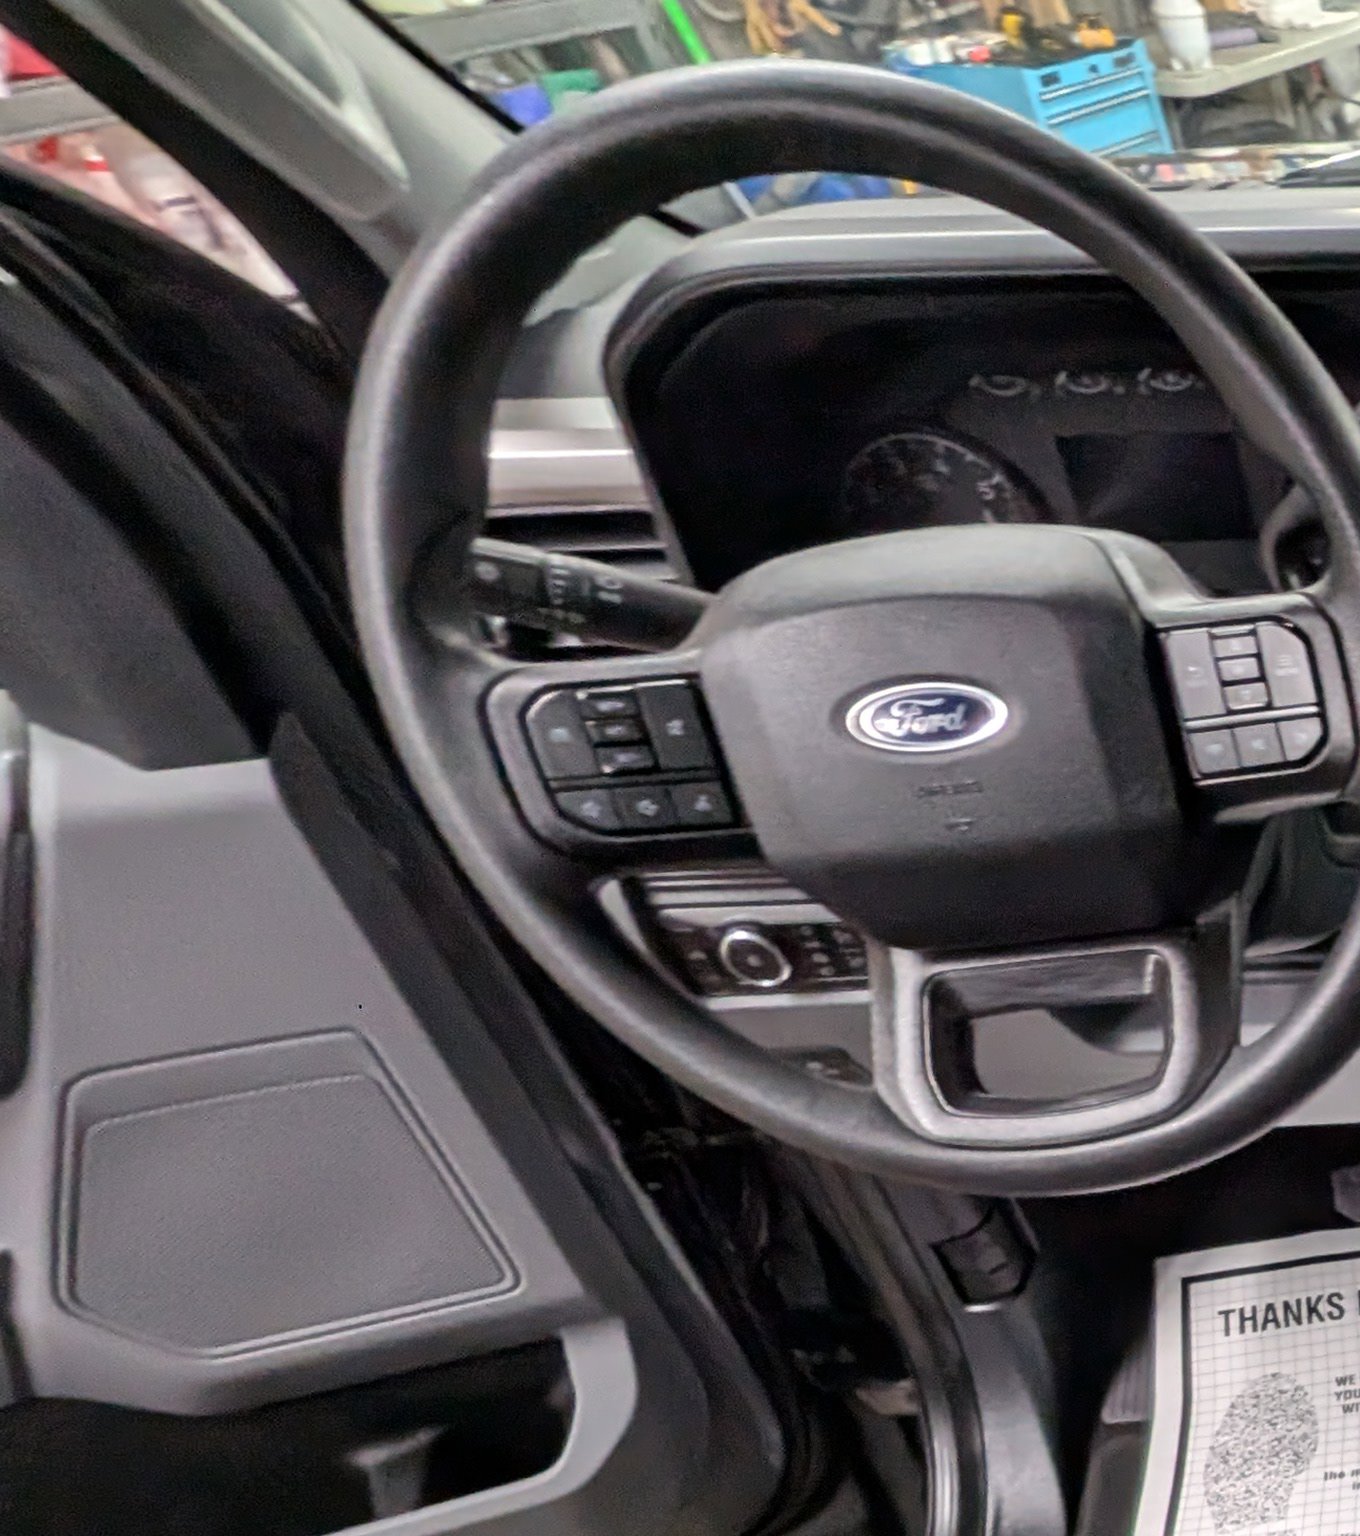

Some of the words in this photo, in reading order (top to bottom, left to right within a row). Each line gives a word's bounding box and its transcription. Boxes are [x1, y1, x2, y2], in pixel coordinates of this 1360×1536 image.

[874, 698, 968, 737] Ford
[1218, 1292, 1345, 1338] THANKS
[1335, 1374, 1356, 1387] WE
[1323, 1467, 1346, 1481] the
